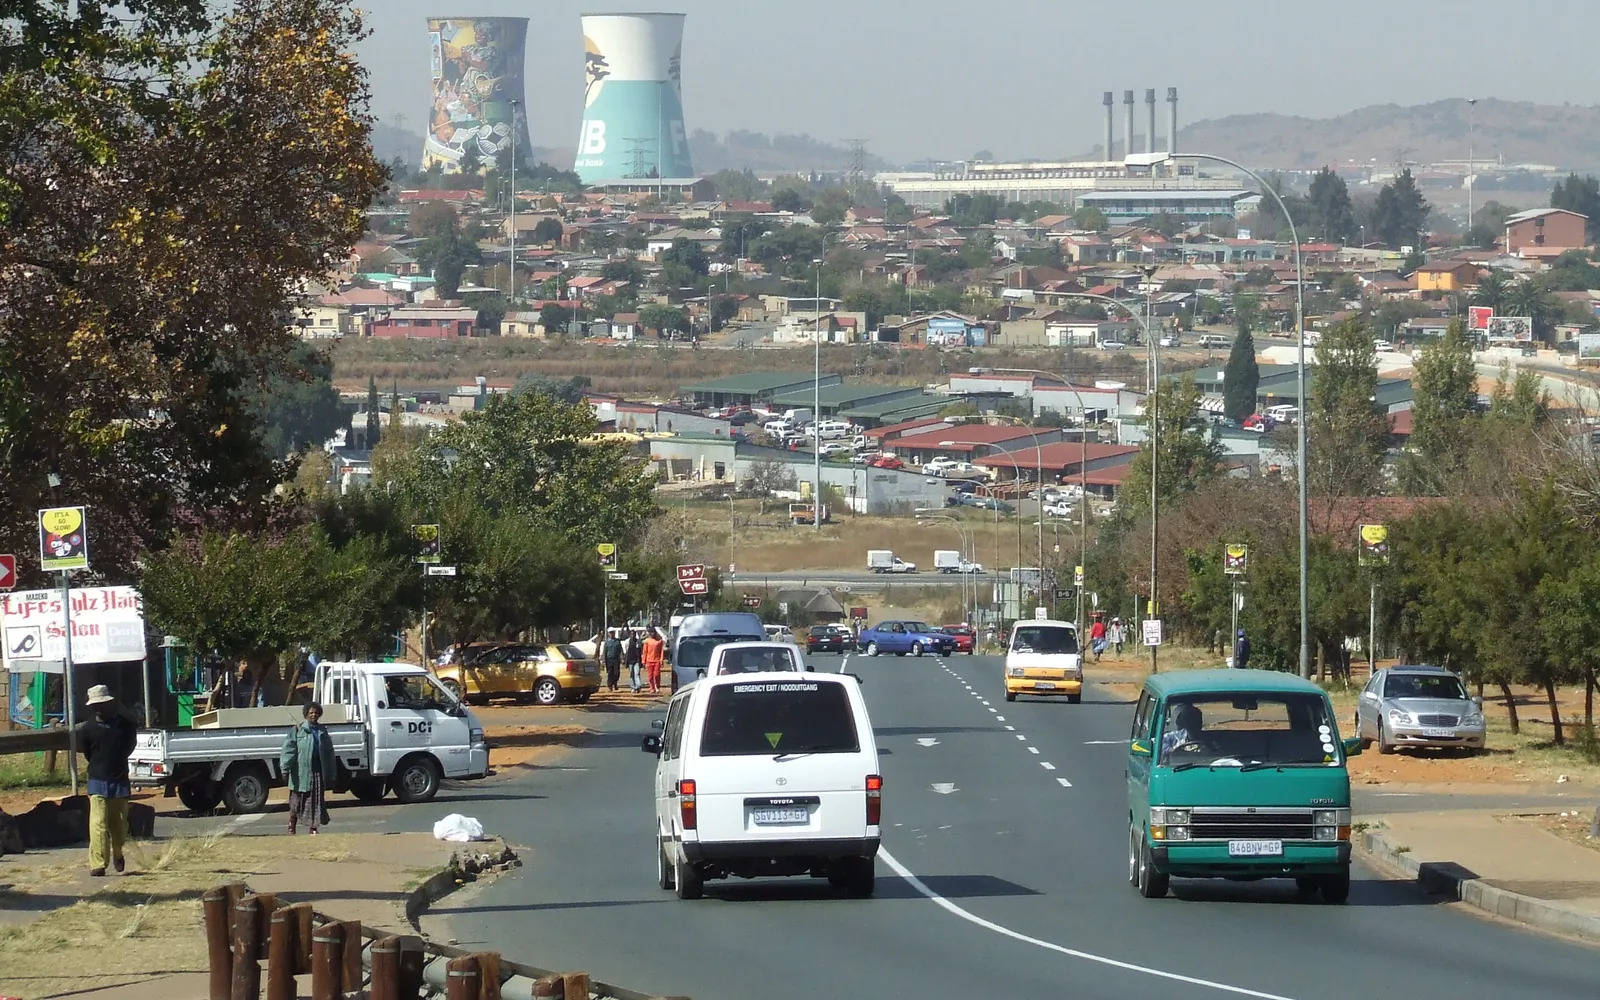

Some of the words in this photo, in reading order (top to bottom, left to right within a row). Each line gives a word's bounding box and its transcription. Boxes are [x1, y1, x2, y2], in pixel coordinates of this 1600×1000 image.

[733, 684, 765, 693] EMERGENCY
[766, 684, 777, 692] EXIT
[780, 683, 818, 692] NOODUITGANG
